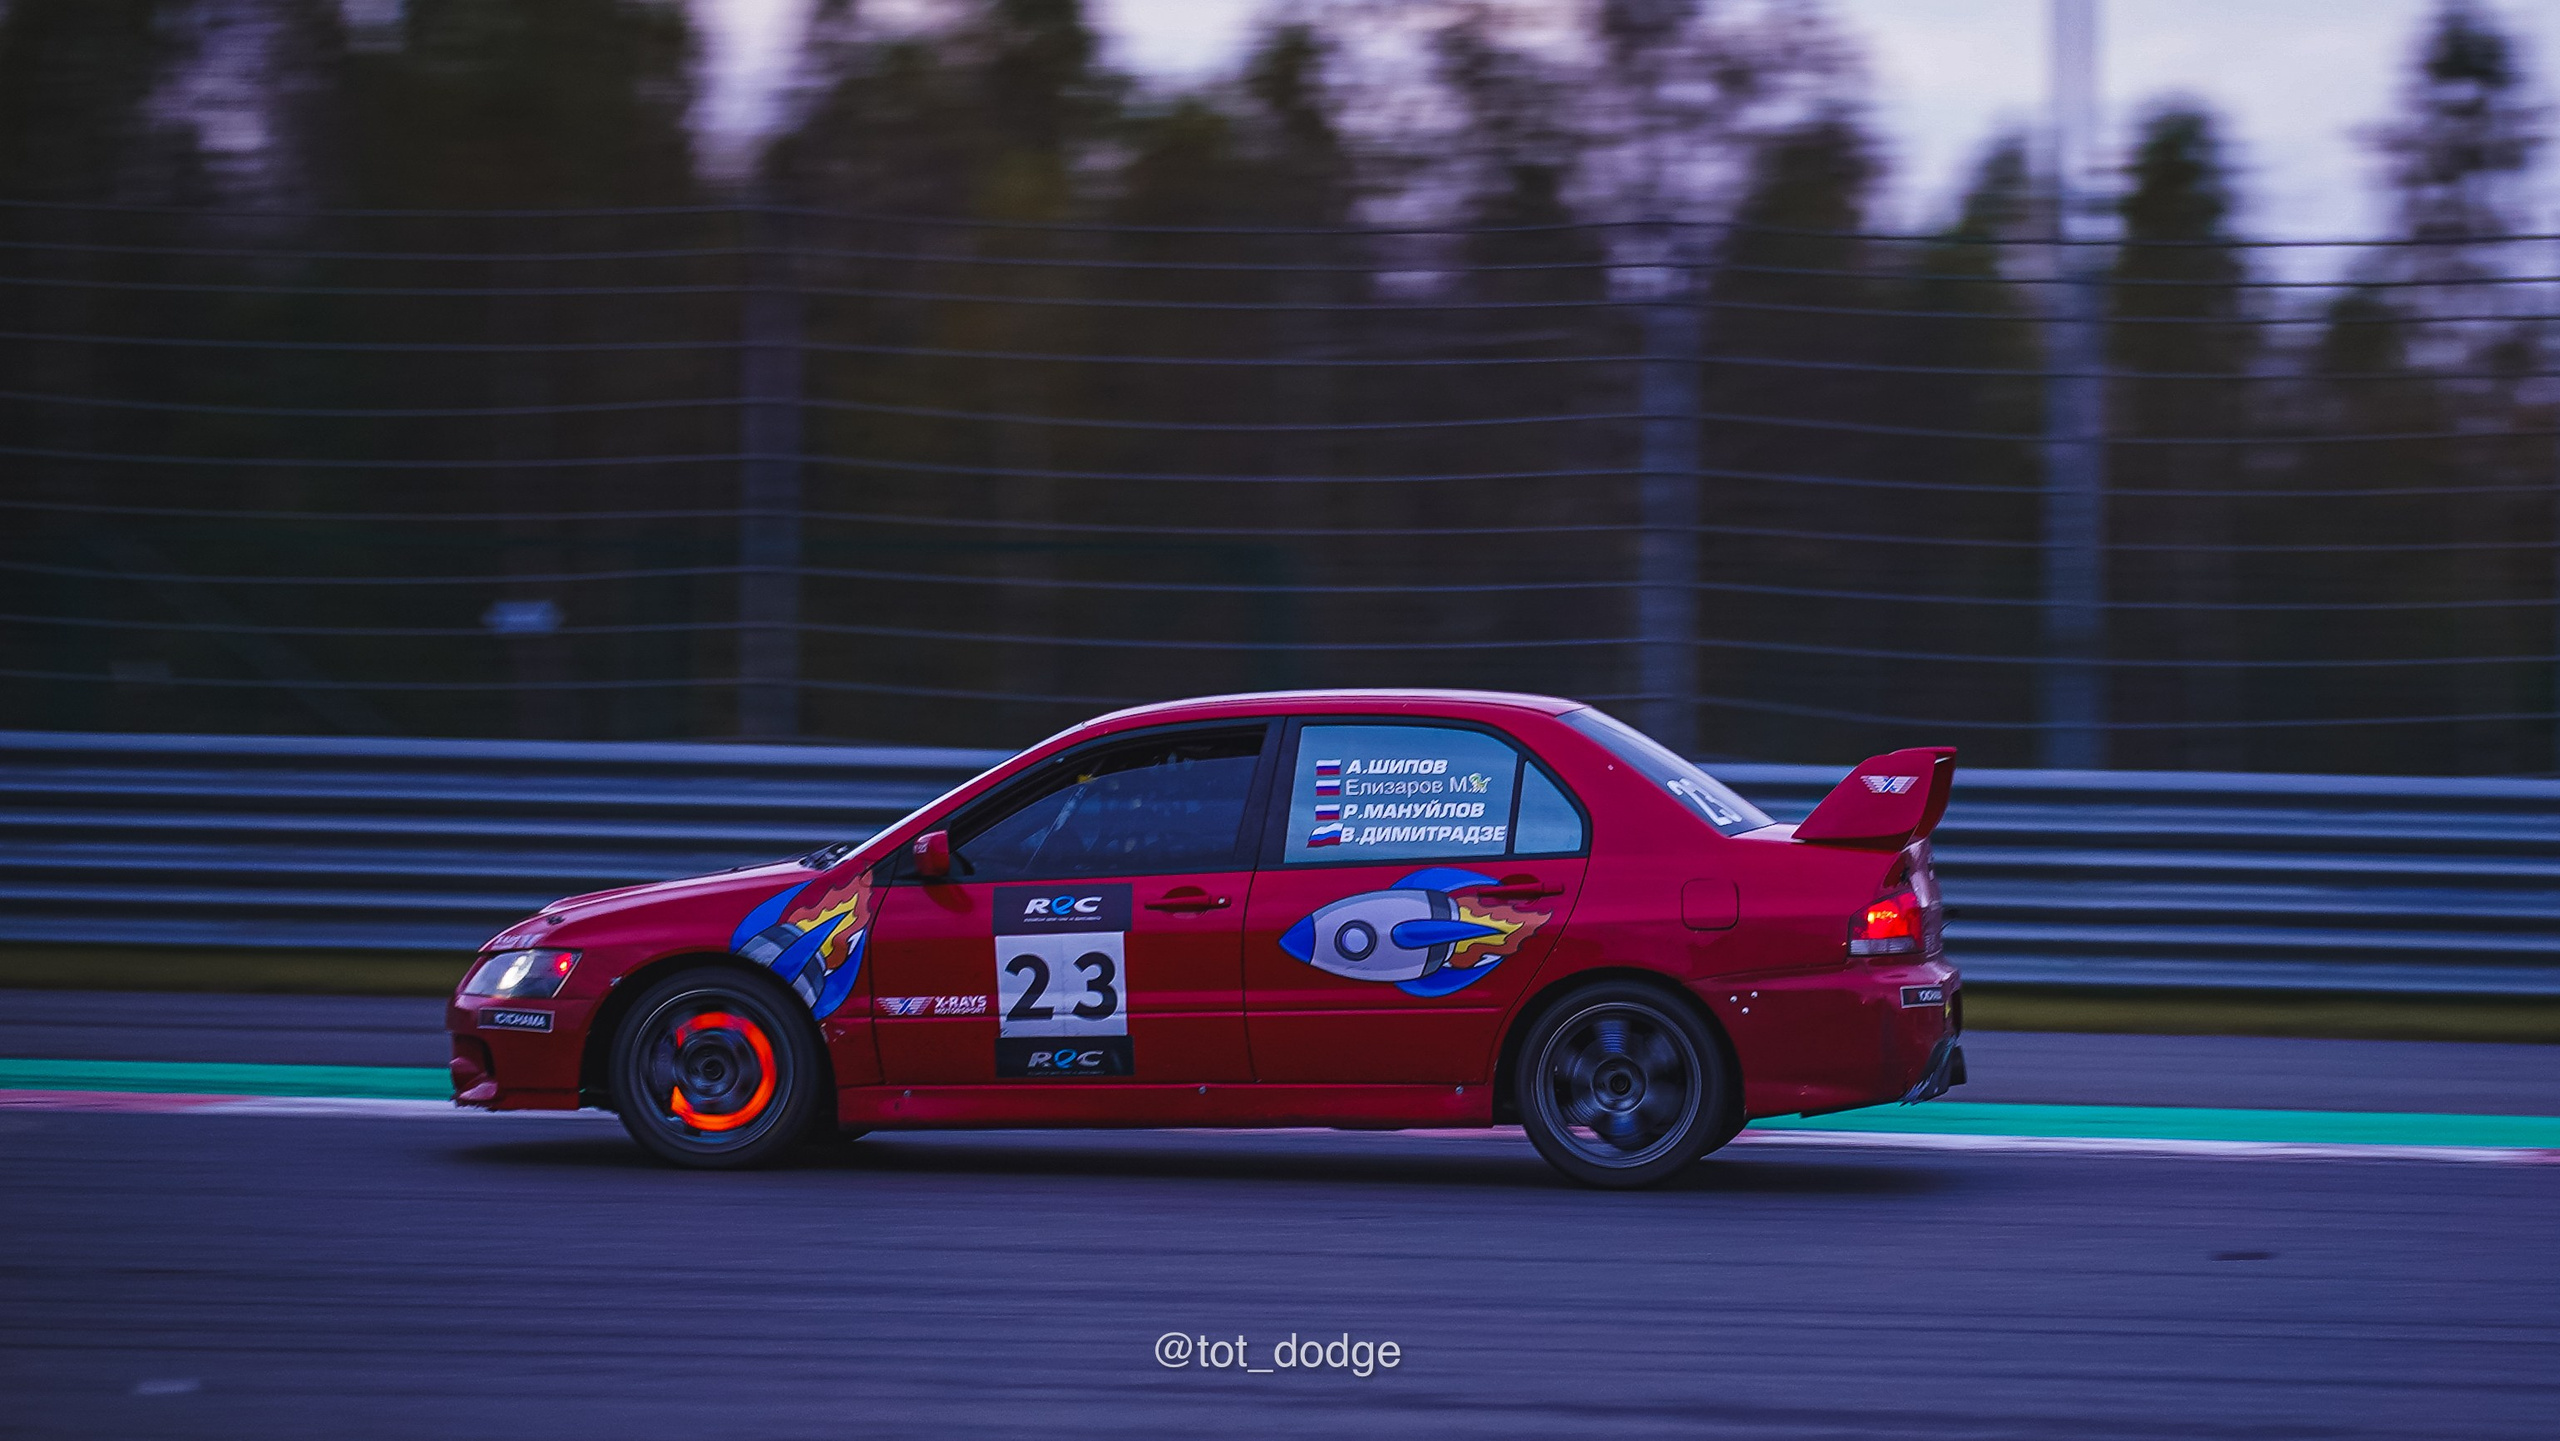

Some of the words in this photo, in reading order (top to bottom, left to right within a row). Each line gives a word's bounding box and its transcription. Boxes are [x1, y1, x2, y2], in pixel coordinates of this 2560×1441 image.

[1345, 758, 1448, 775] А.ШИПОВ
[1345, 778, 1444, 798] Елизаров
[1342, 799, 1485, 819] Р.МАНУЙЛОВ
[1340, 825, 1507, 845] В.ДИМИТРАДЗЕ
[1004, 951, 1118, 1022] 23
[934, 995, 987, 1008] X-RAYS
